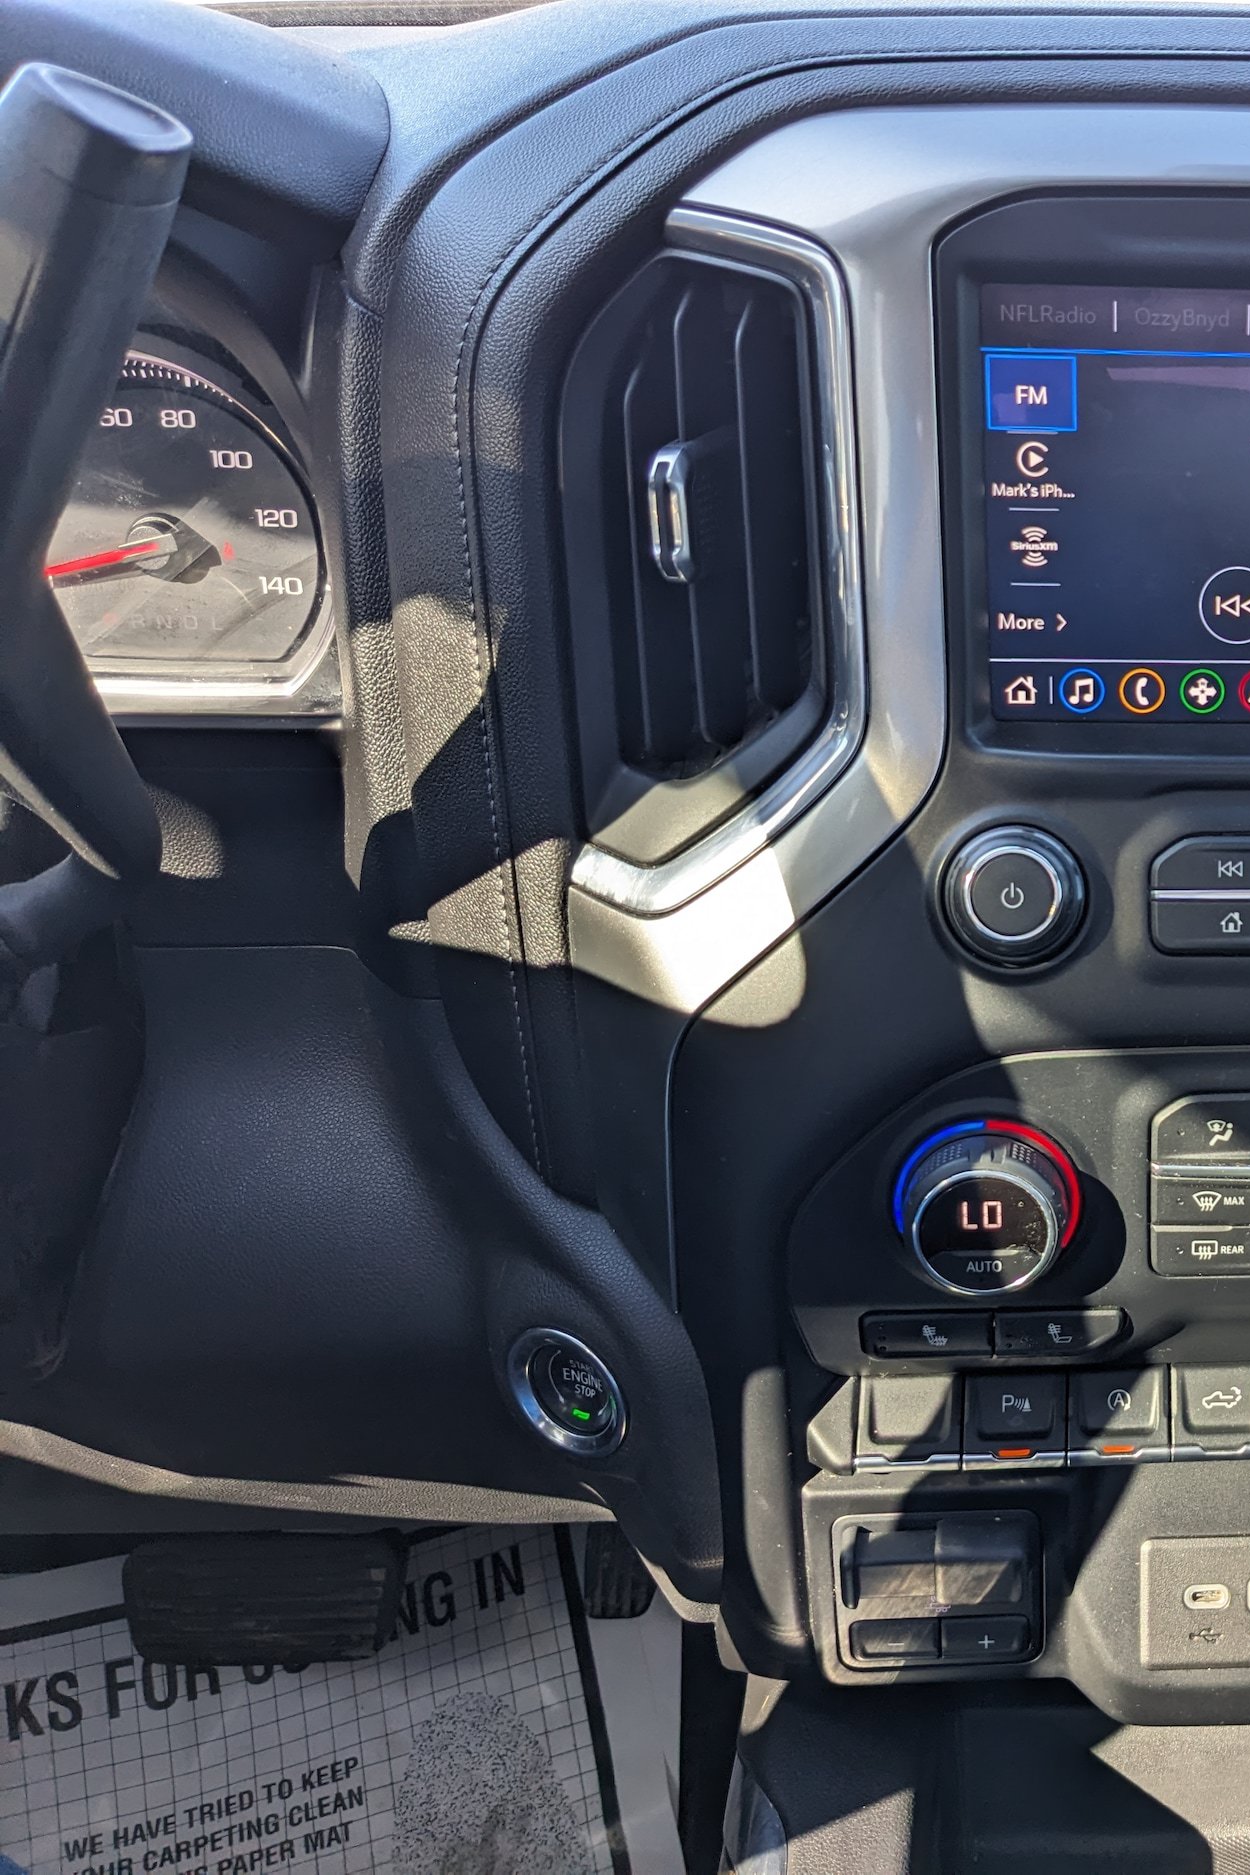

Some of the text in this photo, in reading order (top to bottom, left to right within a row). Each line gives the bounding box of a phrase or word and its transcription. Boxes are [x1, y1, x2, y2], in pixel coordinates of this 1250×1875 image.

[1000, 303, 1097, 324] NFLRadio
[1135, 307, 1230, 332] OzzyBnyd
[1015, 385, 1048, 406] FM
[100, 408, 133, 427] 60
[160, 409, 197, 429] 80
[209, 450, 253, 469] 100
[992, 483, 1039, 498] Mark's
[254, 508, 298, 529] 120
[258, 576, 304, 596] 140
[997, 613, 1045, 631] More
[1223, 1196, 1245, 1206] MAX
[961, 1200, 1003, 1230] LO
[1220, 1244, 1244, 1255] REAR
[966, 1260, 1003, 1273] AUTO
[562, 1367, 604, 1393] ENGINE
[574, 1383, 597, 1399] STOP
[474, 1545, 526, 1610] IN
[64, 1756, 359, 1862] WE HAVE TRIED TO KEEP
[142, 1813, 281, 1872] CARPETING
[288, 1785, 365, 1828] CLEAN
[217, 1820, 354, 1875] PAPER MAT
